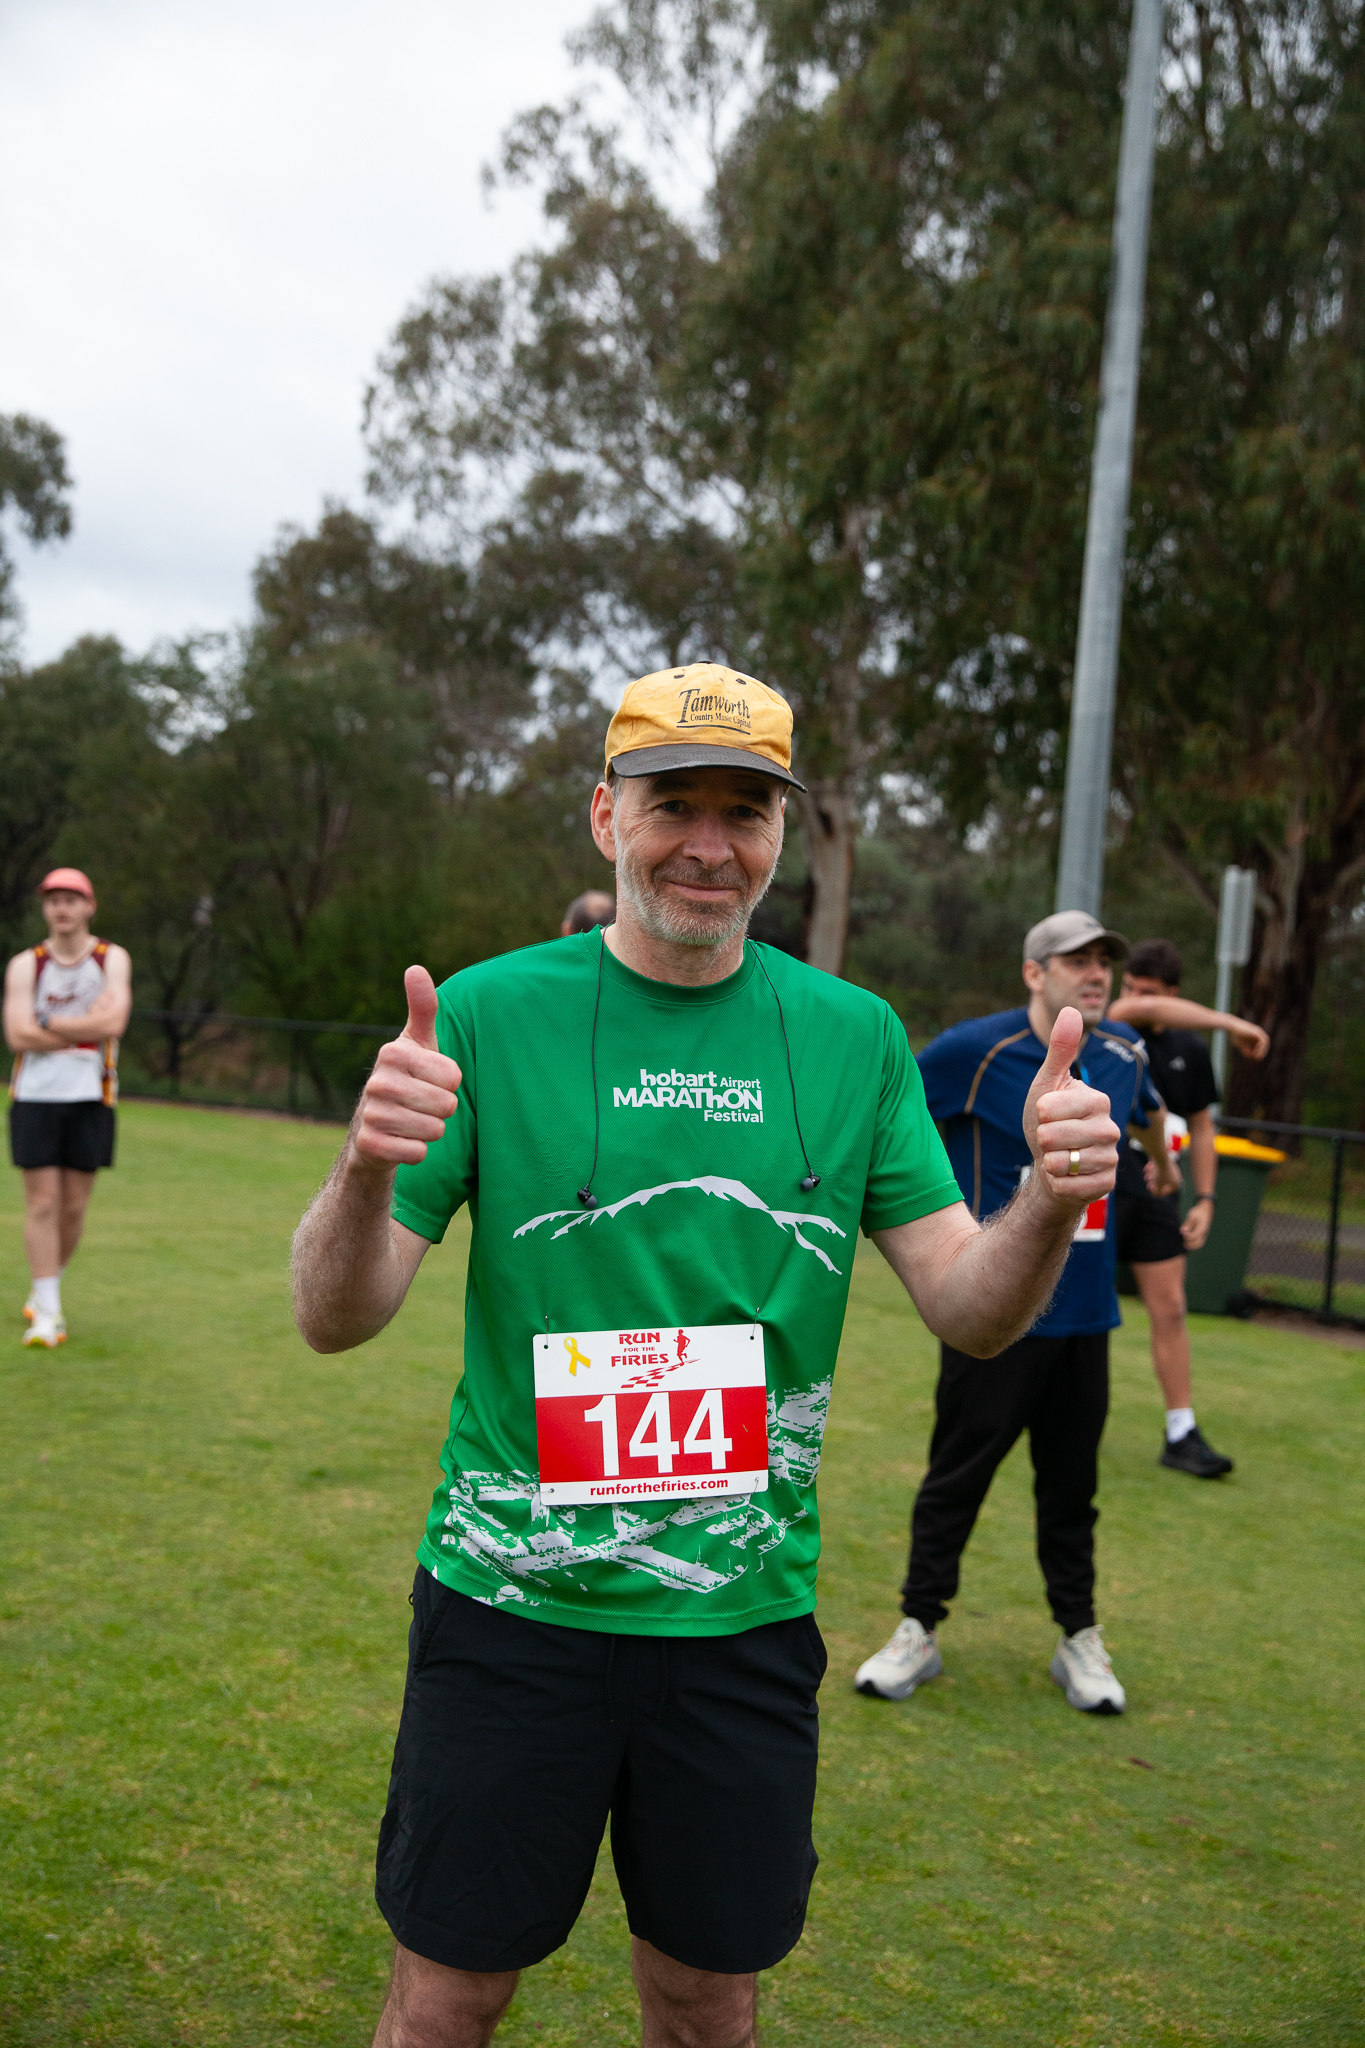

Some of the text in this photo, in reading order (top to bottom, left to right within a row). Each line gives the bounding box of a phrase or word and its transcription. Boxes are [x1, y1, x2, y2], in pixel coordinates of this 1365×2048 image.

[677, 688, 751, 723] Tamworth
[690, 712, 752, 728] Country Music Capital
[639, 1068, 761, 1091] hobart Airport
[703, 1109, 764, 1123] Festival
[618, 1332, 661, 1346] RUN
[611, 1353, 669, 1367] FIRIES
[584, 1389, 733, 1477] 144
[590, 1479, 729, 1496] runforthefiries.com
